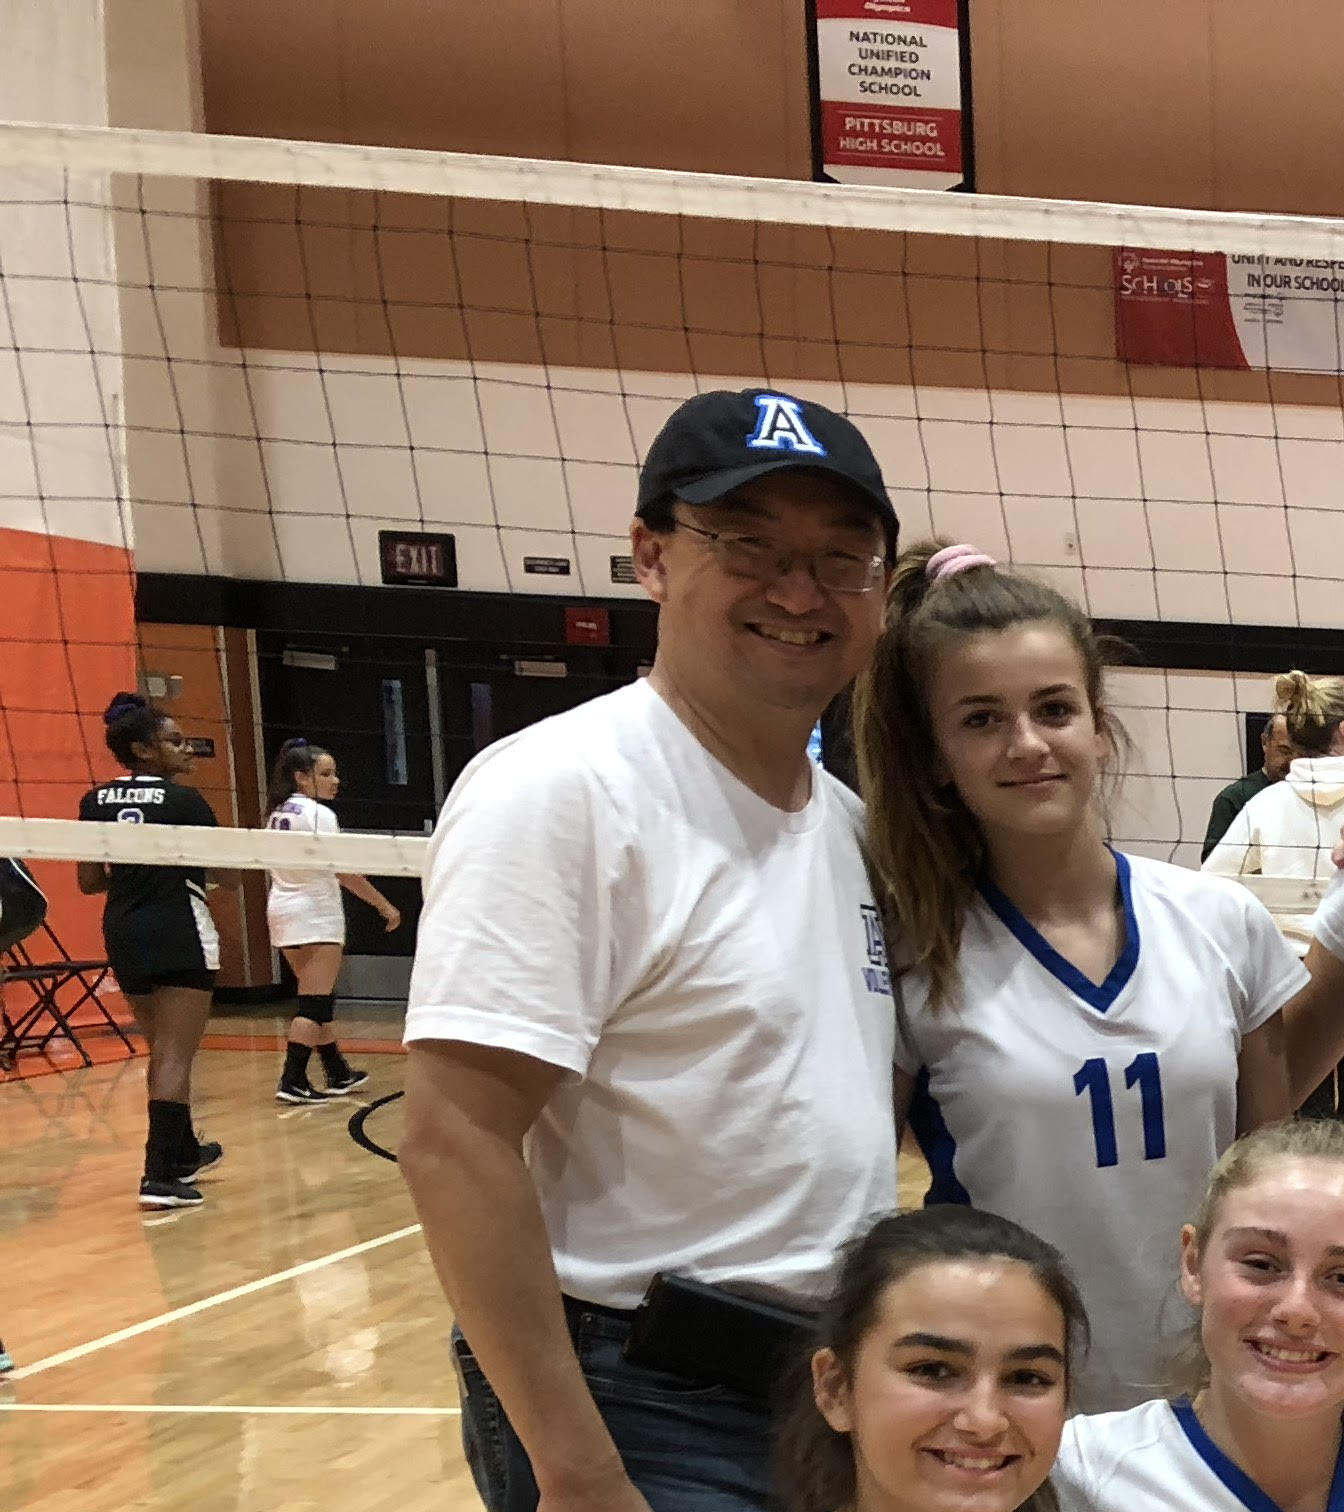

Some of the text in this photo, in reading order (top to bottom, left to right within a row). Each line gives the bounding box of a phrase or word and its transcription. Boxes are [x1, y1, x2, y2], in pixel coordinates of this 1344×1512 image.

[849, 31, 928, 48] NATIONAL
[858, 48, 920, 64] UNIFIED
[848, 63, 931, 81] CHAMPION
[859, 81, 922, 97] SCHOOL
[845, 117, 938, 137] PITTSBURG
[839, 137, 945, 156] HIGH SCHOOL
[1247, 273, 1261, 288] IN
[1263, 273, 1292, 289] OUR
[746, 394, 828, 458] A
[395, 543, 441, 576] EXIT
[97, 787, 165, 805] FALCONS
[1074, 1053, 1165, 1167] 11
